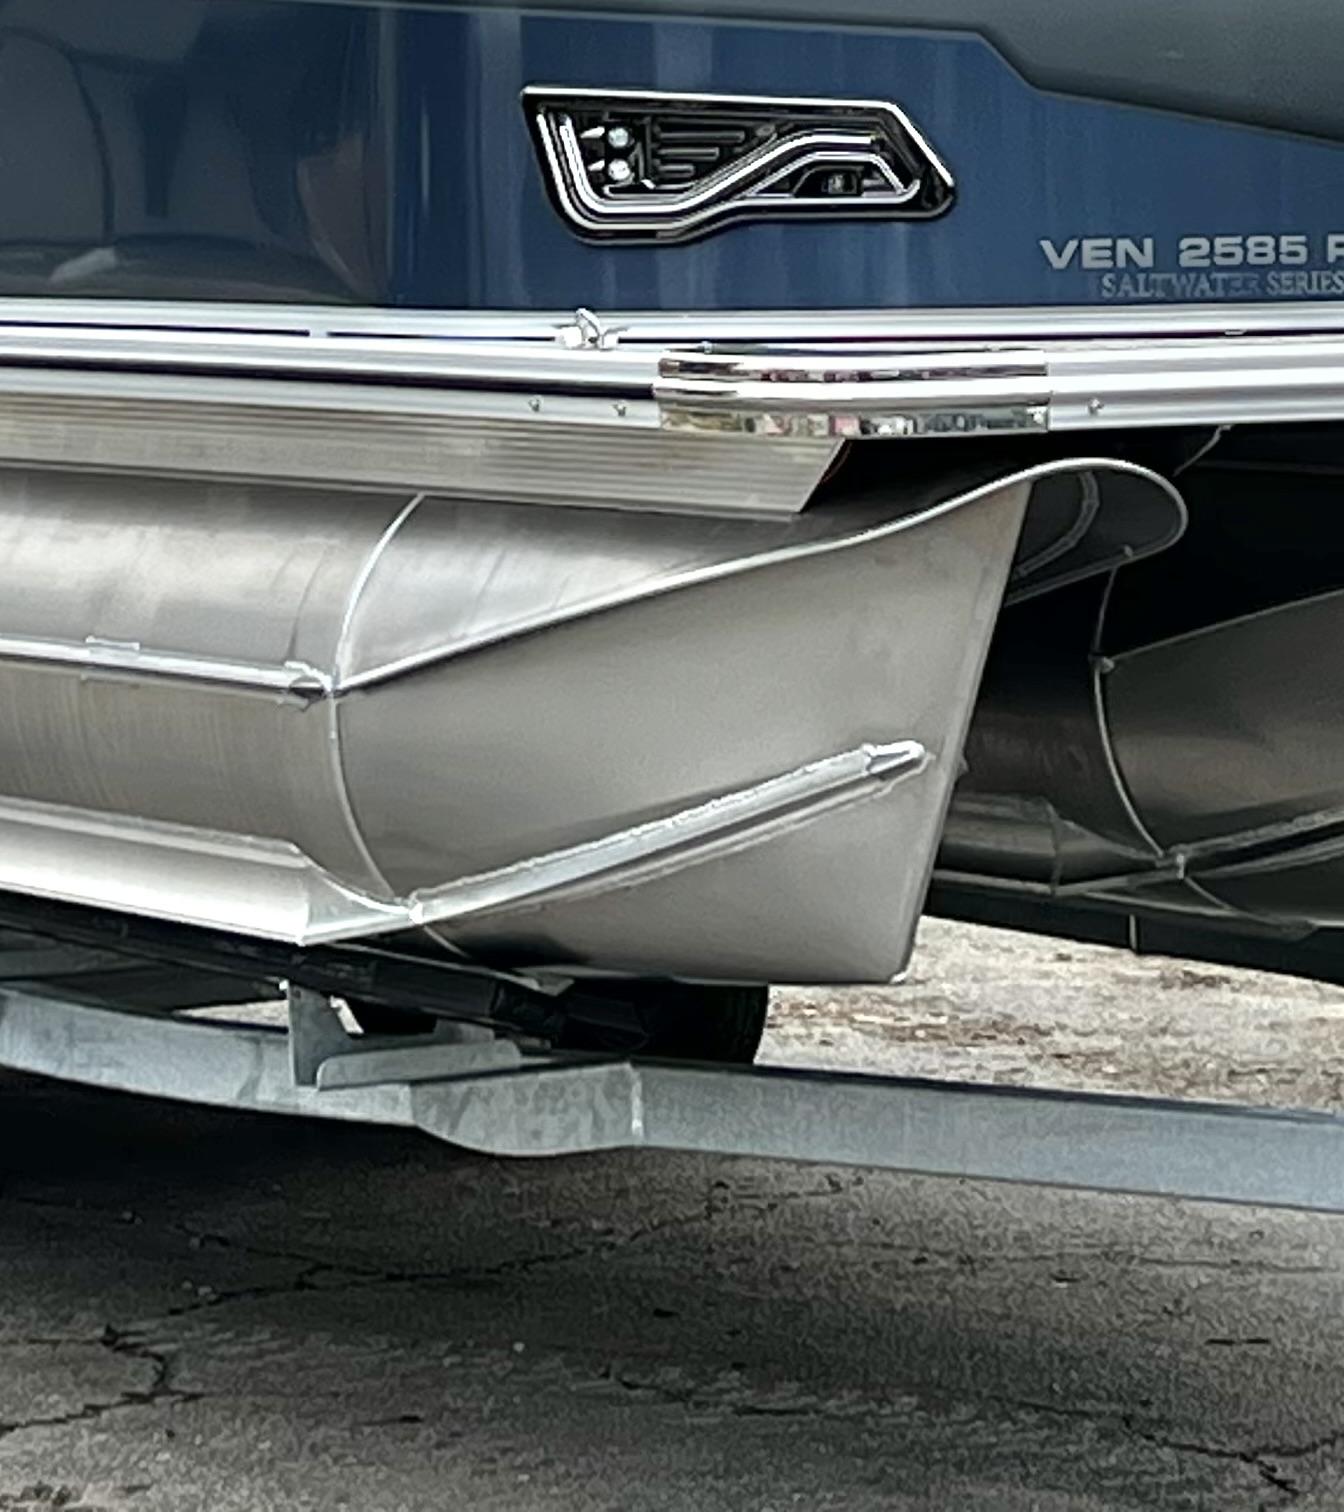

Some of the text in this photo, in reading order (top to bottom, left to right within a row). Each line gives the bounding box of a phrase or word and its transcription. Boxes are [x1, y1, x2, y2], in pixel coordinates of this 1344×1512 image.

[1040, 237, 1154, 270] VEN
[1178, 235, 1308, 268] 2585
[1101, 272, 1260, 299] SALTWATER
